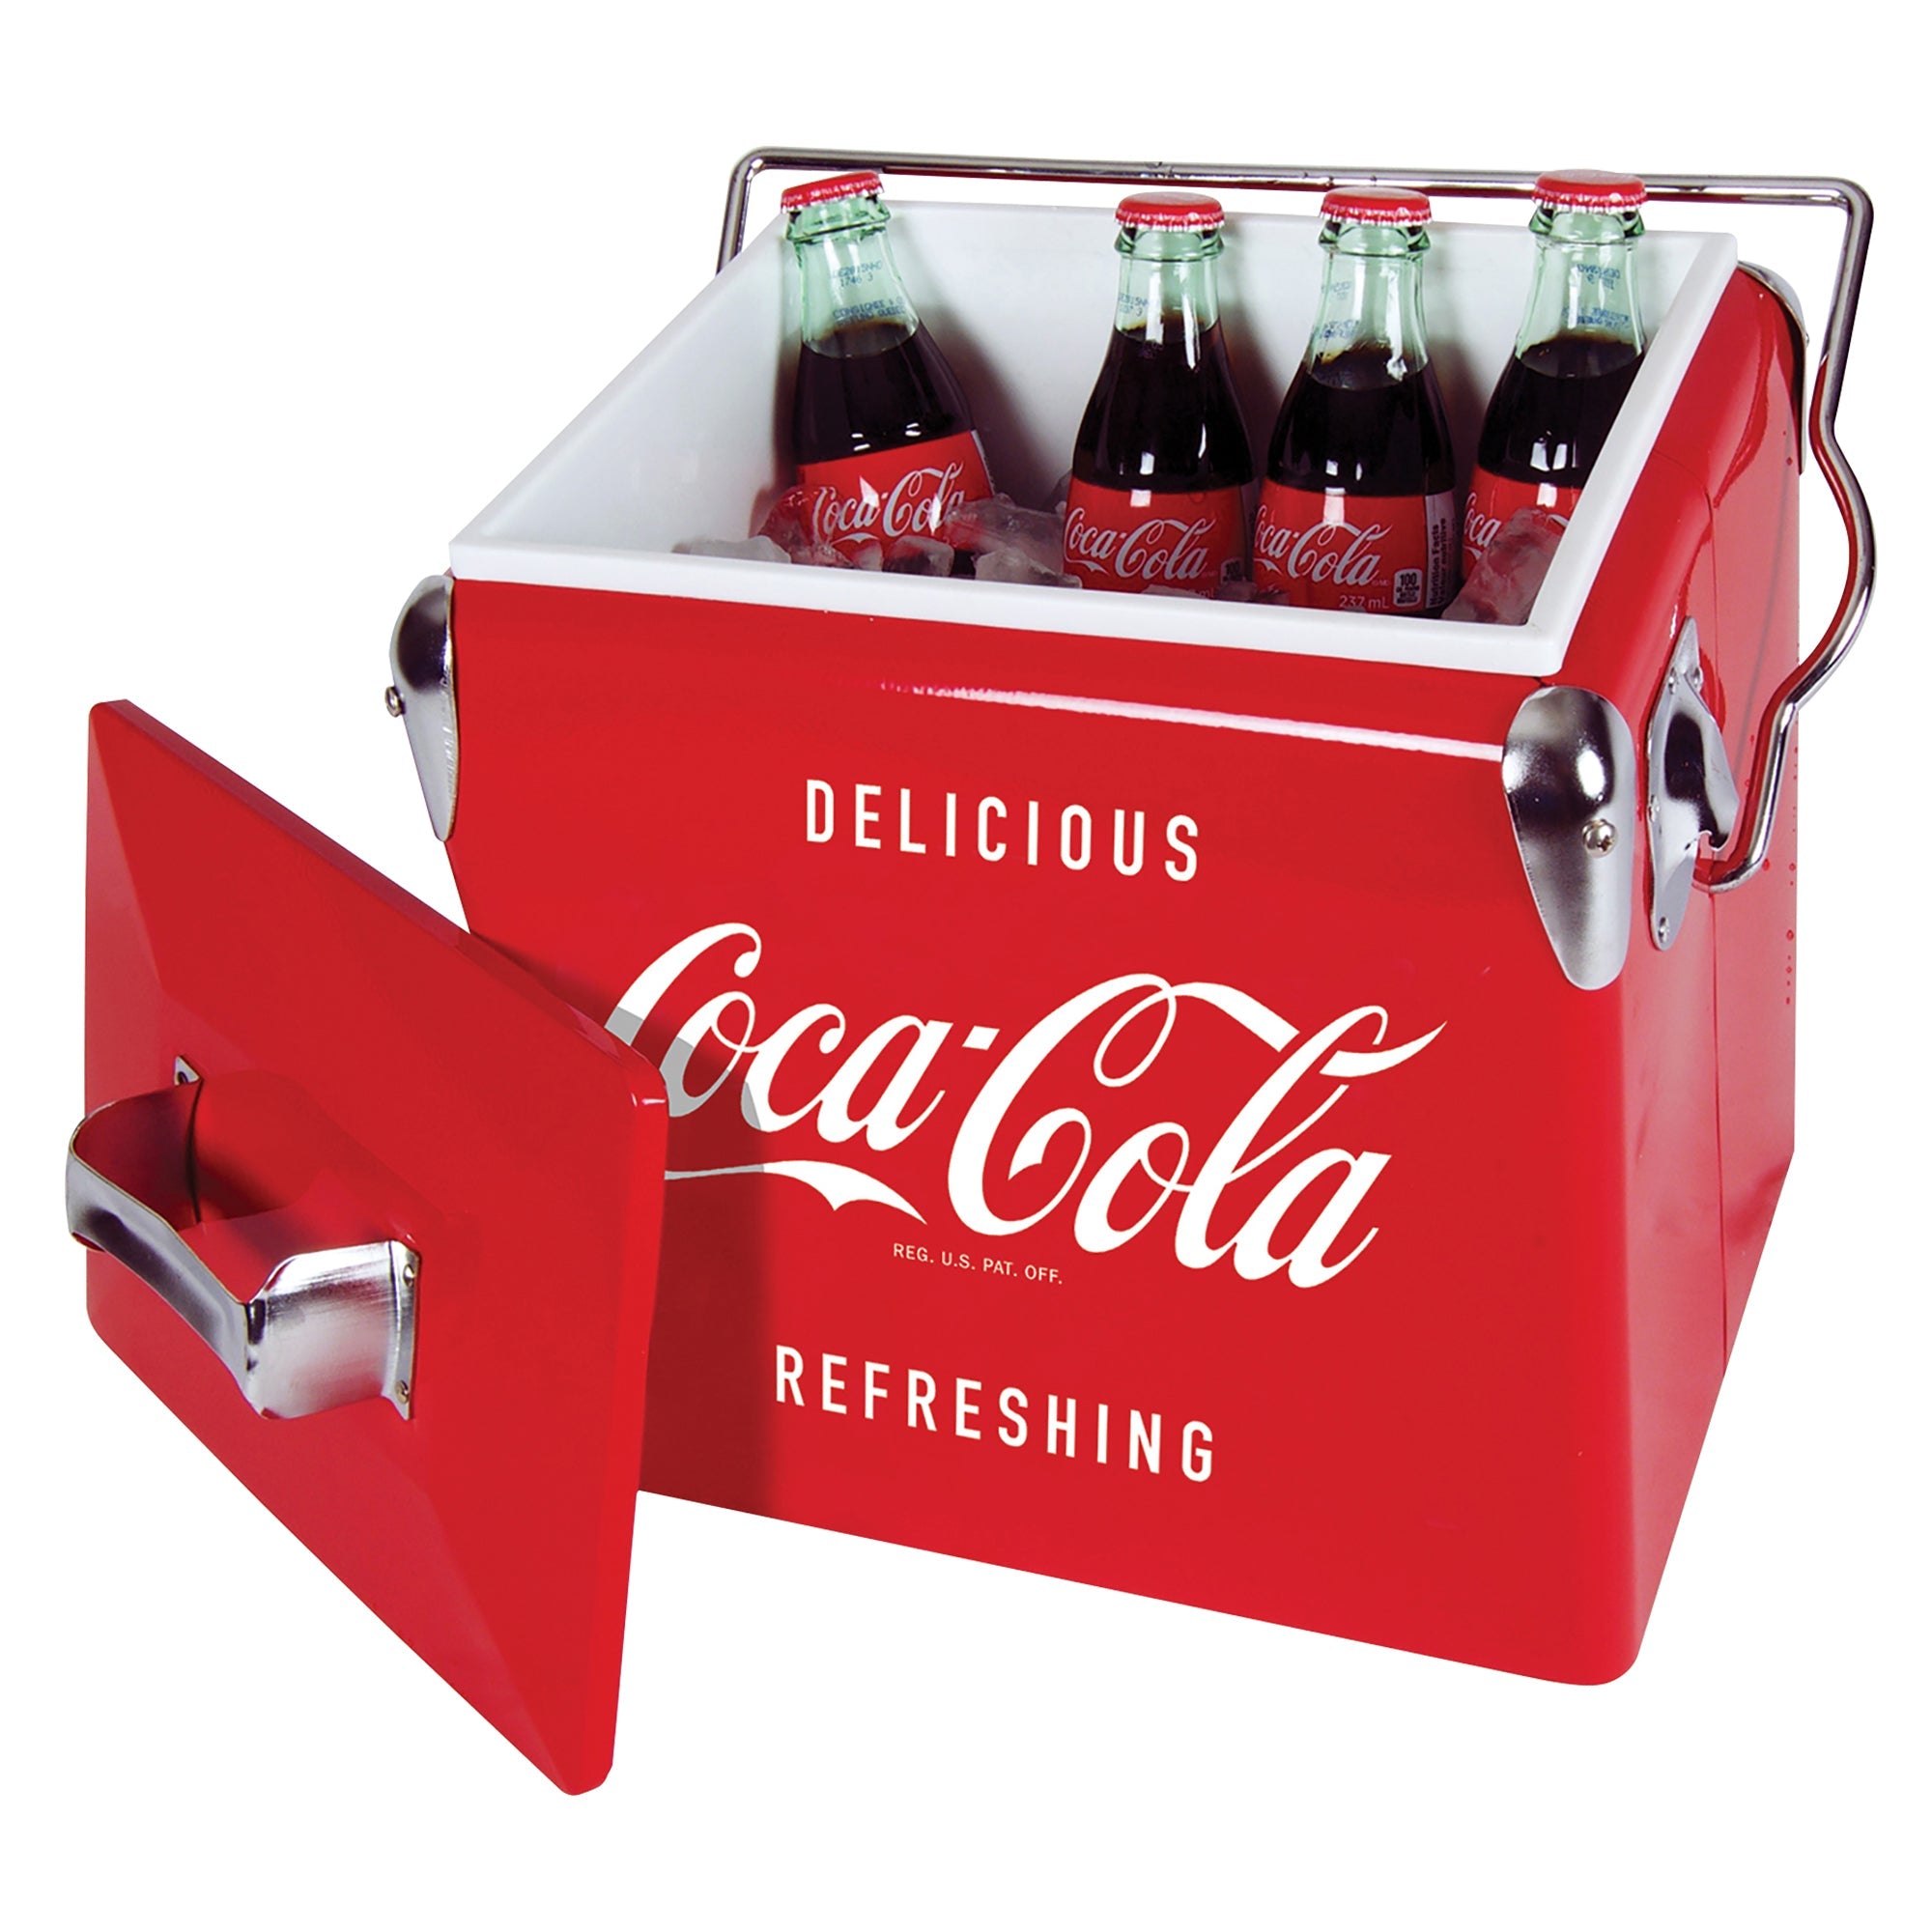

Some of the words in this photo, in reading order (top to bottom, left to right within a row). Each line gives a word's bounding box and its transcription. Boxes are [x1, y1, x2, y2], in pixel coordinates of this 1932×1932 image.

[1065, 507, 1217, 580] Coca-Cola
[1255, 504, 1394, 586] Coca-Cola
[1399, 572, 1418, 586] 100
[1339, 595, 1363, 609] 237
[1367, 595, 1389, 610] mL
[805, 778, 1201, 883] DELICIOUS
[604, 922, 1448, 1289] Coca-Cola
[893, 1242, 934, 1264] REG.
[941, 1251, 976, 1271] U.S.
[982, 1257, 1018, 1277] PAT.
[1024, 1264, 1064, 1285] OFF.
[775, 1343, 1214, 1483] REFRESHING
